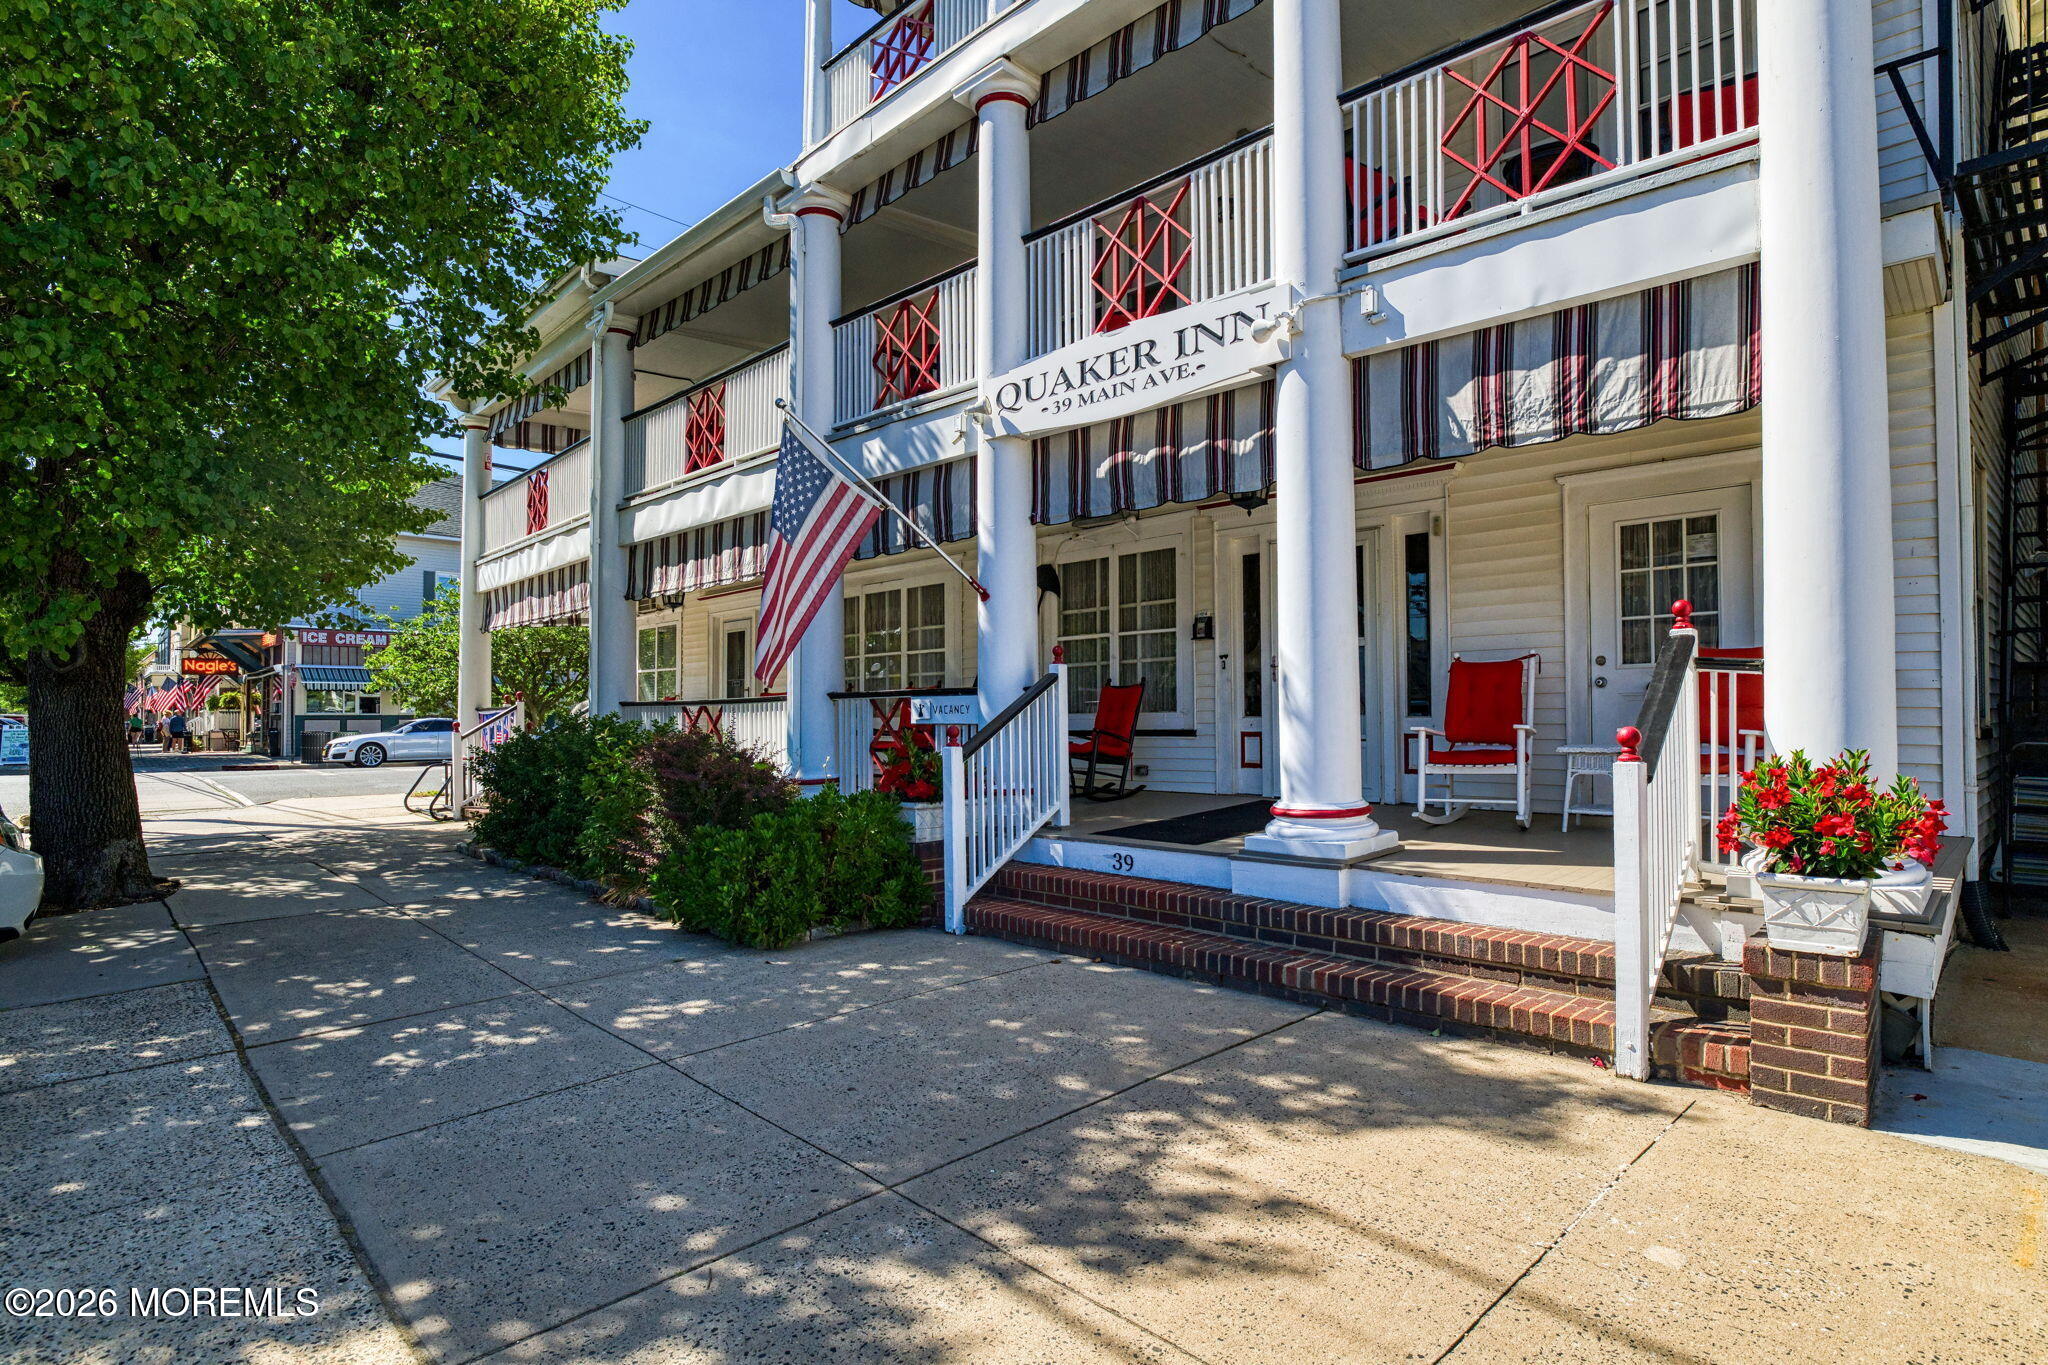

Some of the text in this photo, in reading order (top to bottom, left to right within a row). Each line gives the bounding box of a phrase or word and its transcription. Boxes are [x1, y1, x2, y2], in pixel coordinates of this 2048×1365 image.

[996, 302, 1271, 415] QUAKER INN
[1078, 377, 1136, 408] MAIN
[302, 631, 387, 645] ICE CREAM
[184, 659, 237, 674] Nagle's
[933, 704, 970, 716] VACANCY
[1112, 852, 1134, 871] 39
